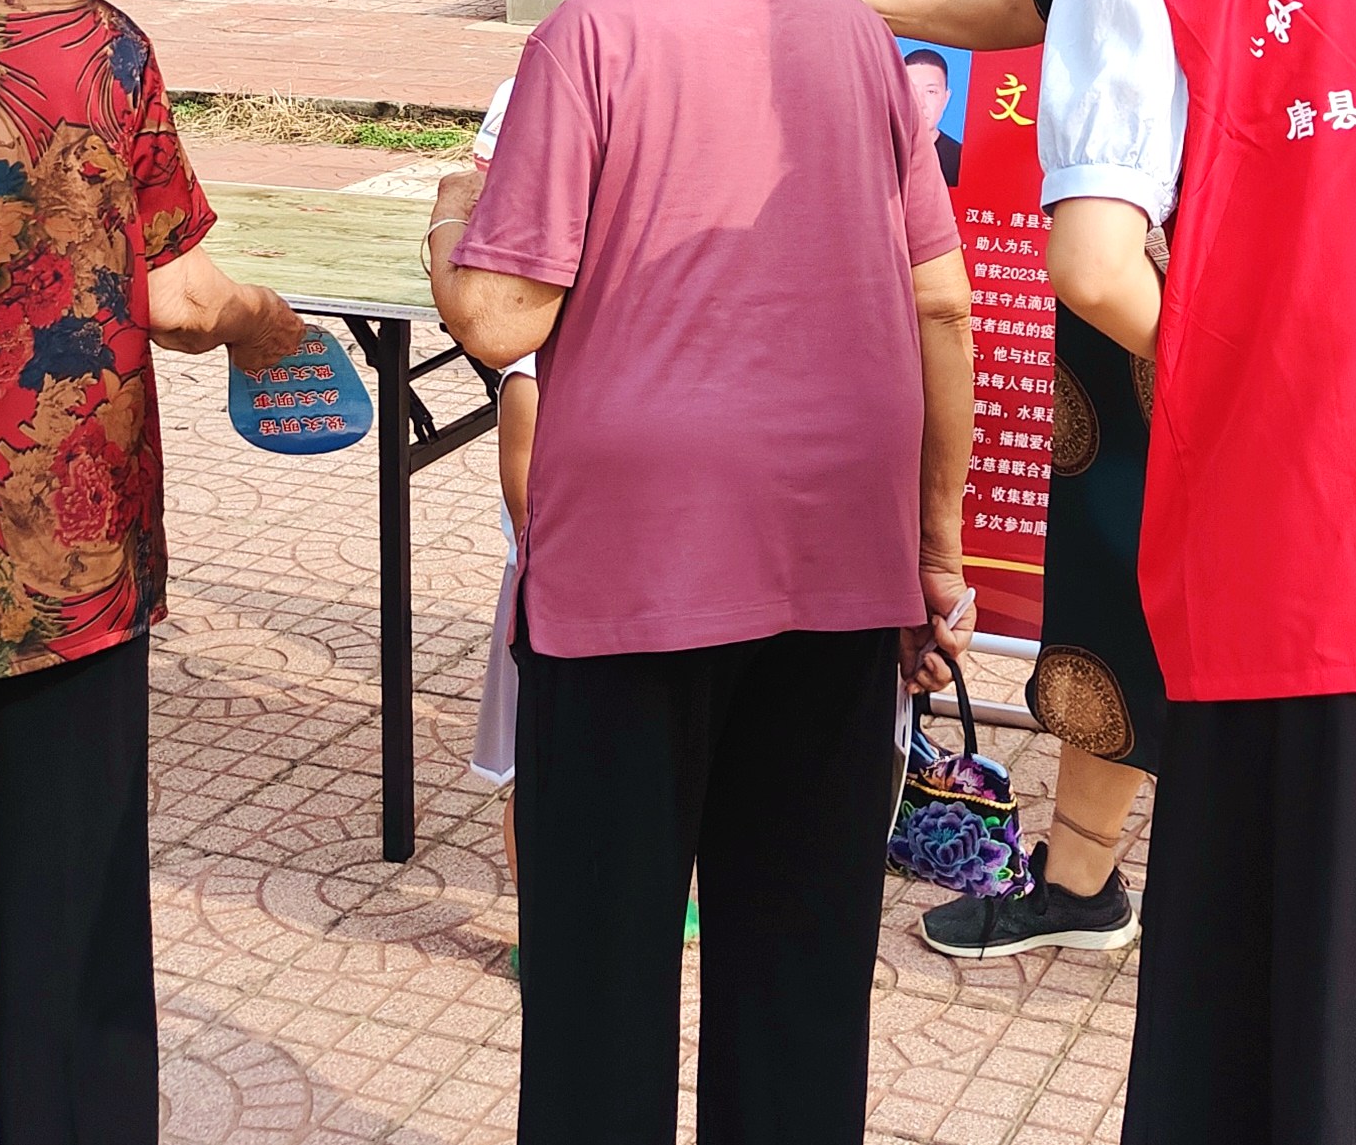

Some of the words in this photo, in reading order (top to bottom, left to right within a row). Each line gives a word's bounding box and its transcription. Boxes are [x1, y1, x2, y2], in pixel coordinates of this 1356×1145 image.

[988, 73, 1036, 126] 文
[253, 389, 340, 410] 办文明事
[259, 415, 347, 436] 说文明话
